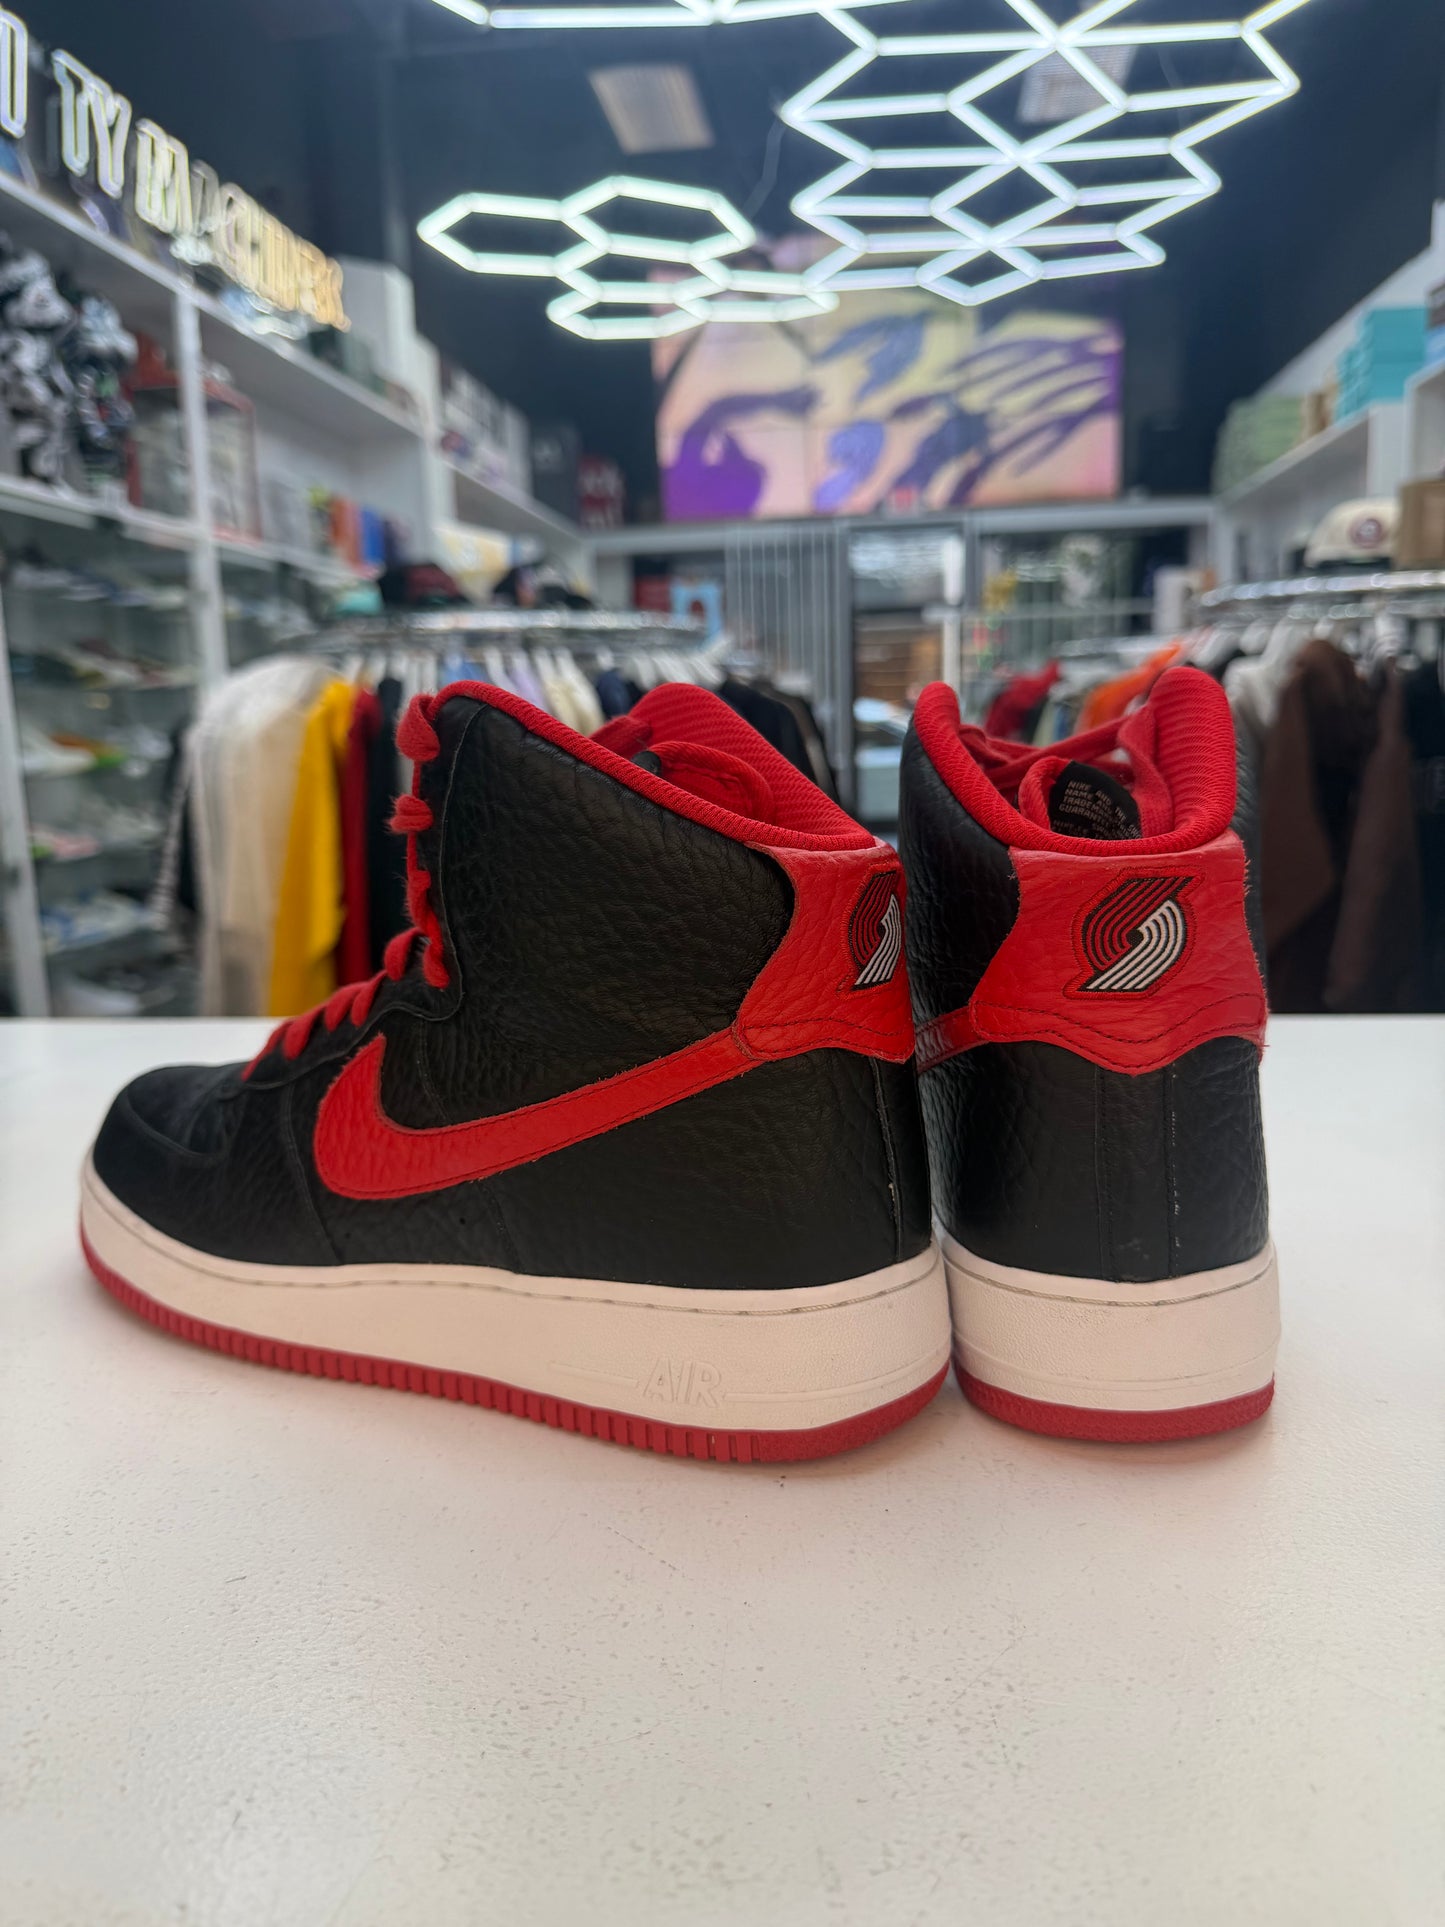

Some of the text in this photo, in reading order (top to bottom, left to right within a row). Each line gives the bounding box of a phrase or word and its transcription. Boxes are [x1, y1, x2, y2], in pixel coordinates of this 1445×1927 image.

[1064, 788, 1094, 801] NAME
[1068, 780, 1092, 791] NIKE
[1095, 790, 1112, 806] AND
[643, 1356, 722, 1408] AIR
